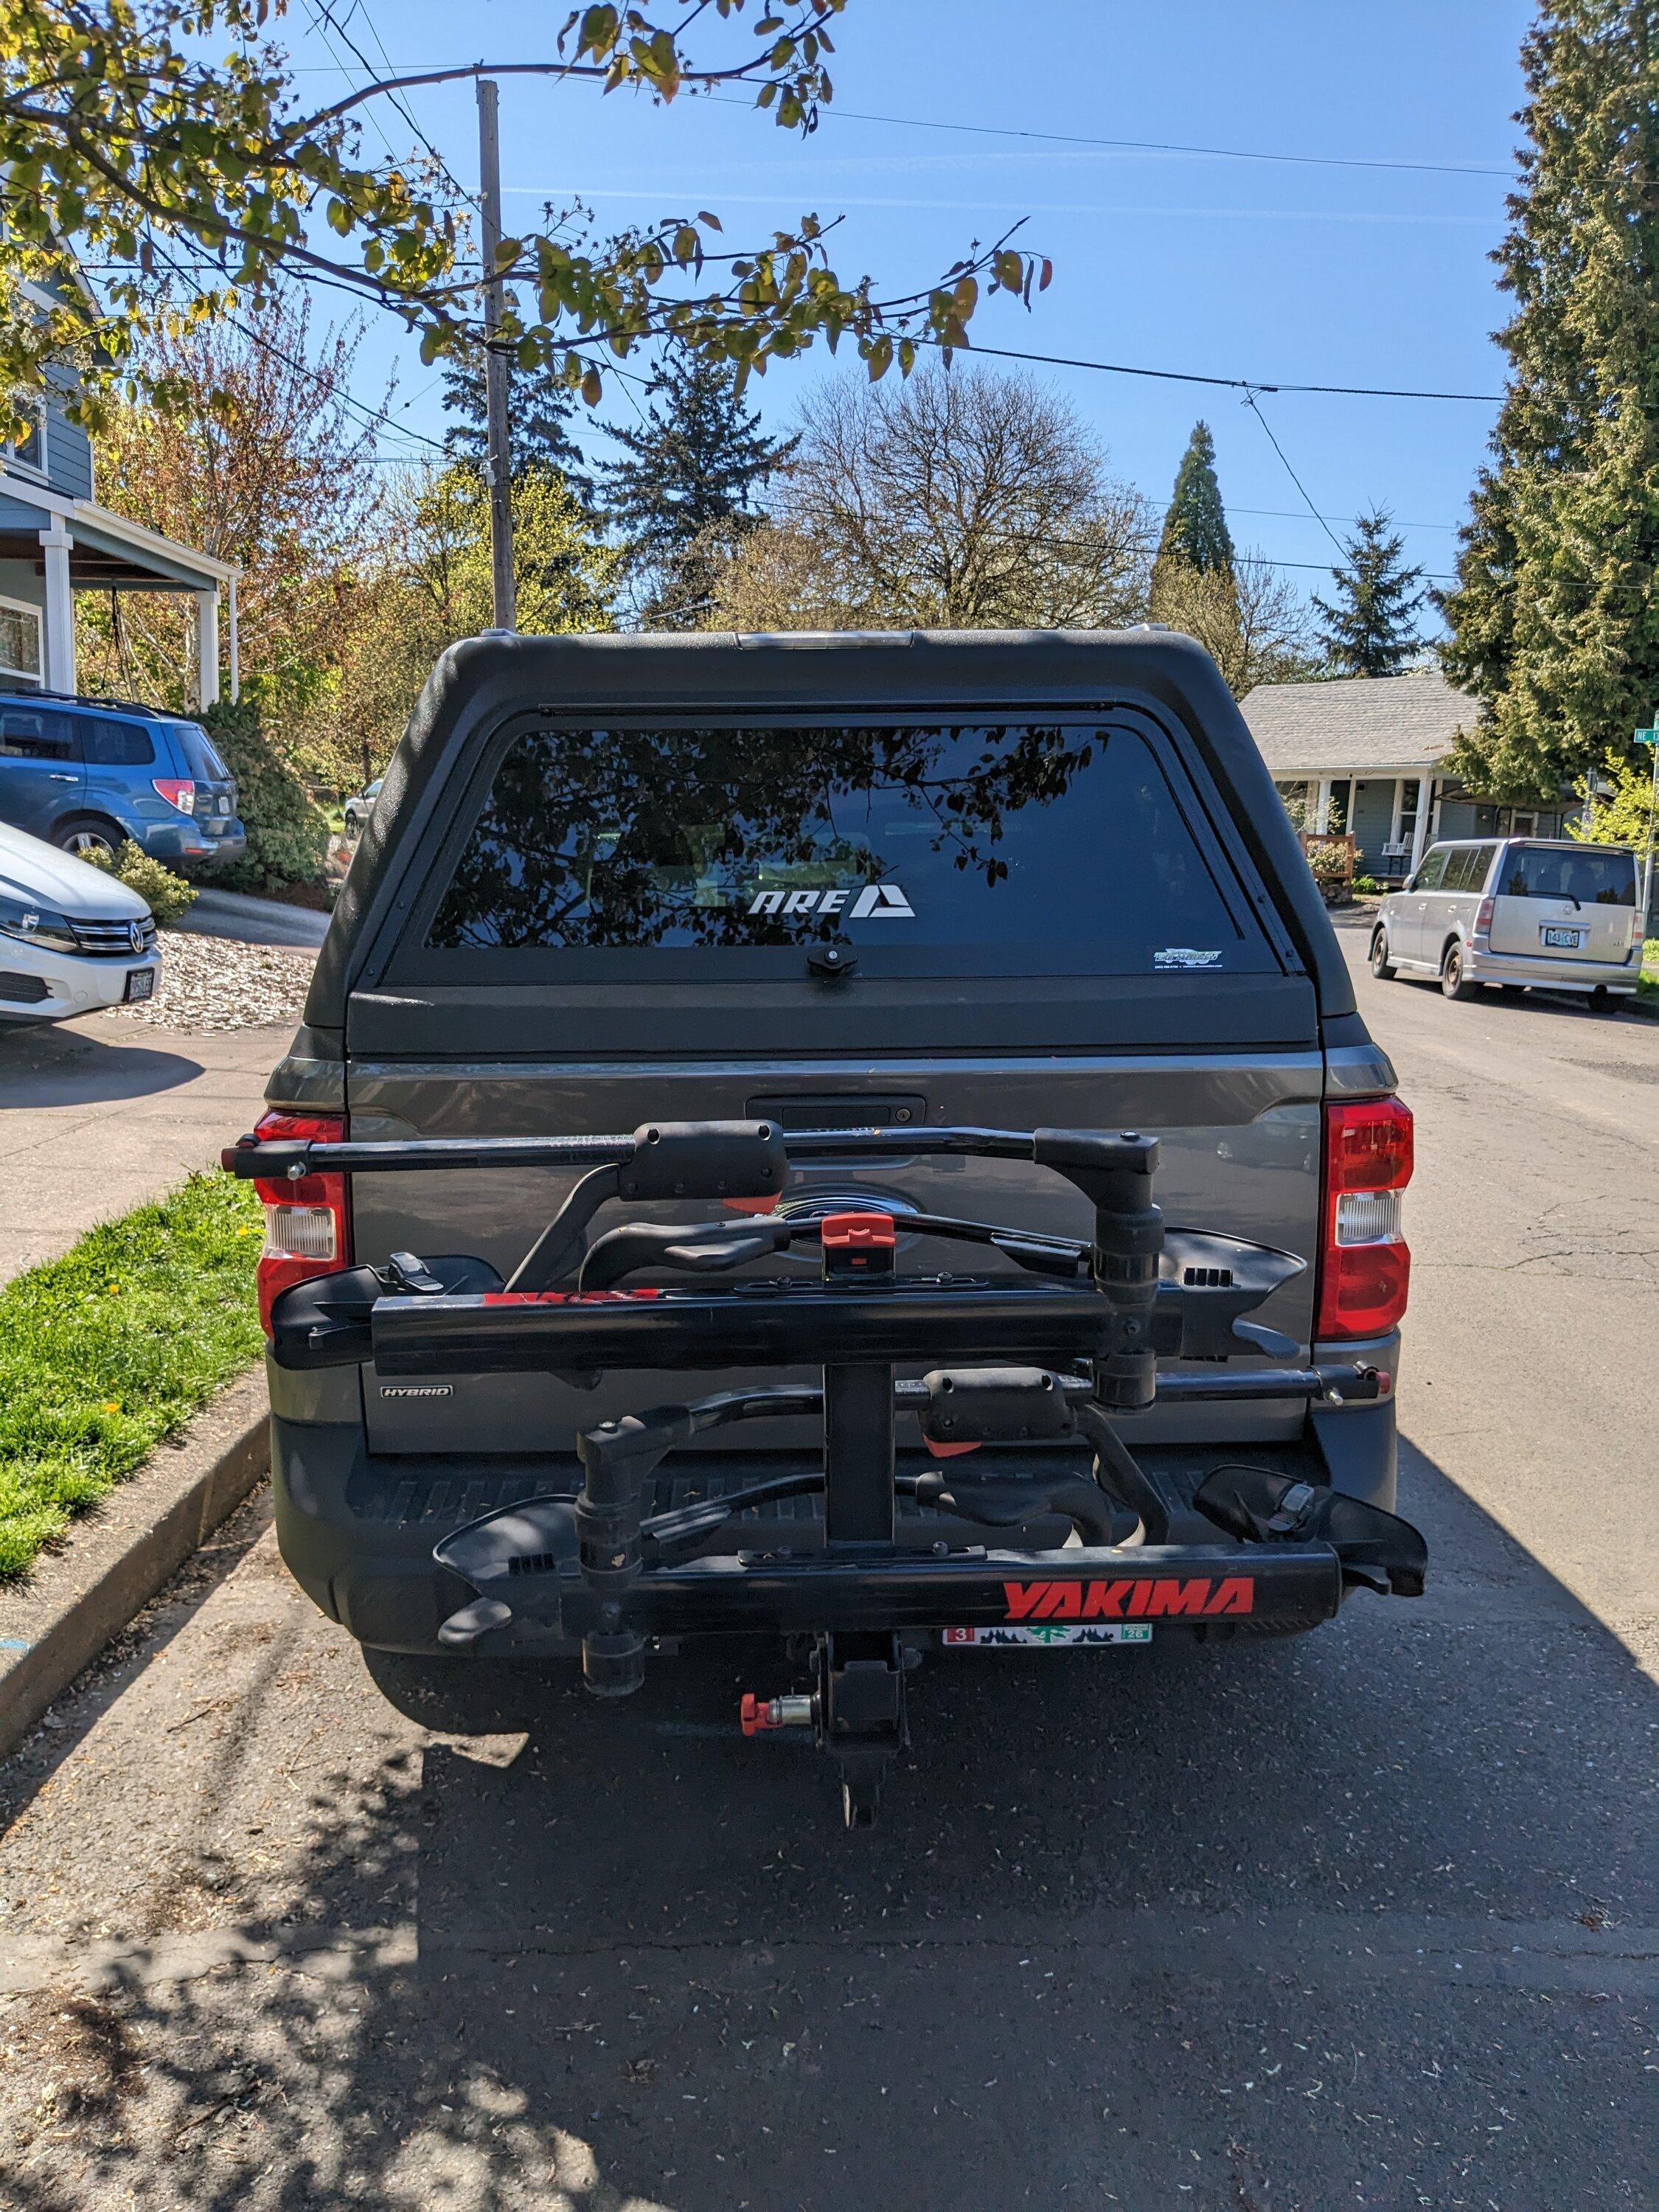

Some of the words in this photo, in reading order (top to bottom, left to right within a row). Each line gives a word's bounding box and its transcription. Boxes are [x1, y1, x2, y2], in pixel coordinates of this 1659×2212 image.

[1637, 731, 1646, 740] NE
[748, 889, 852, 914] ARE
[384, 1388, 450, 1397] HYBRID
[1003, 1576, 1254, 1620] YAKIMA
[955, 1627, 967, 1641] 3
